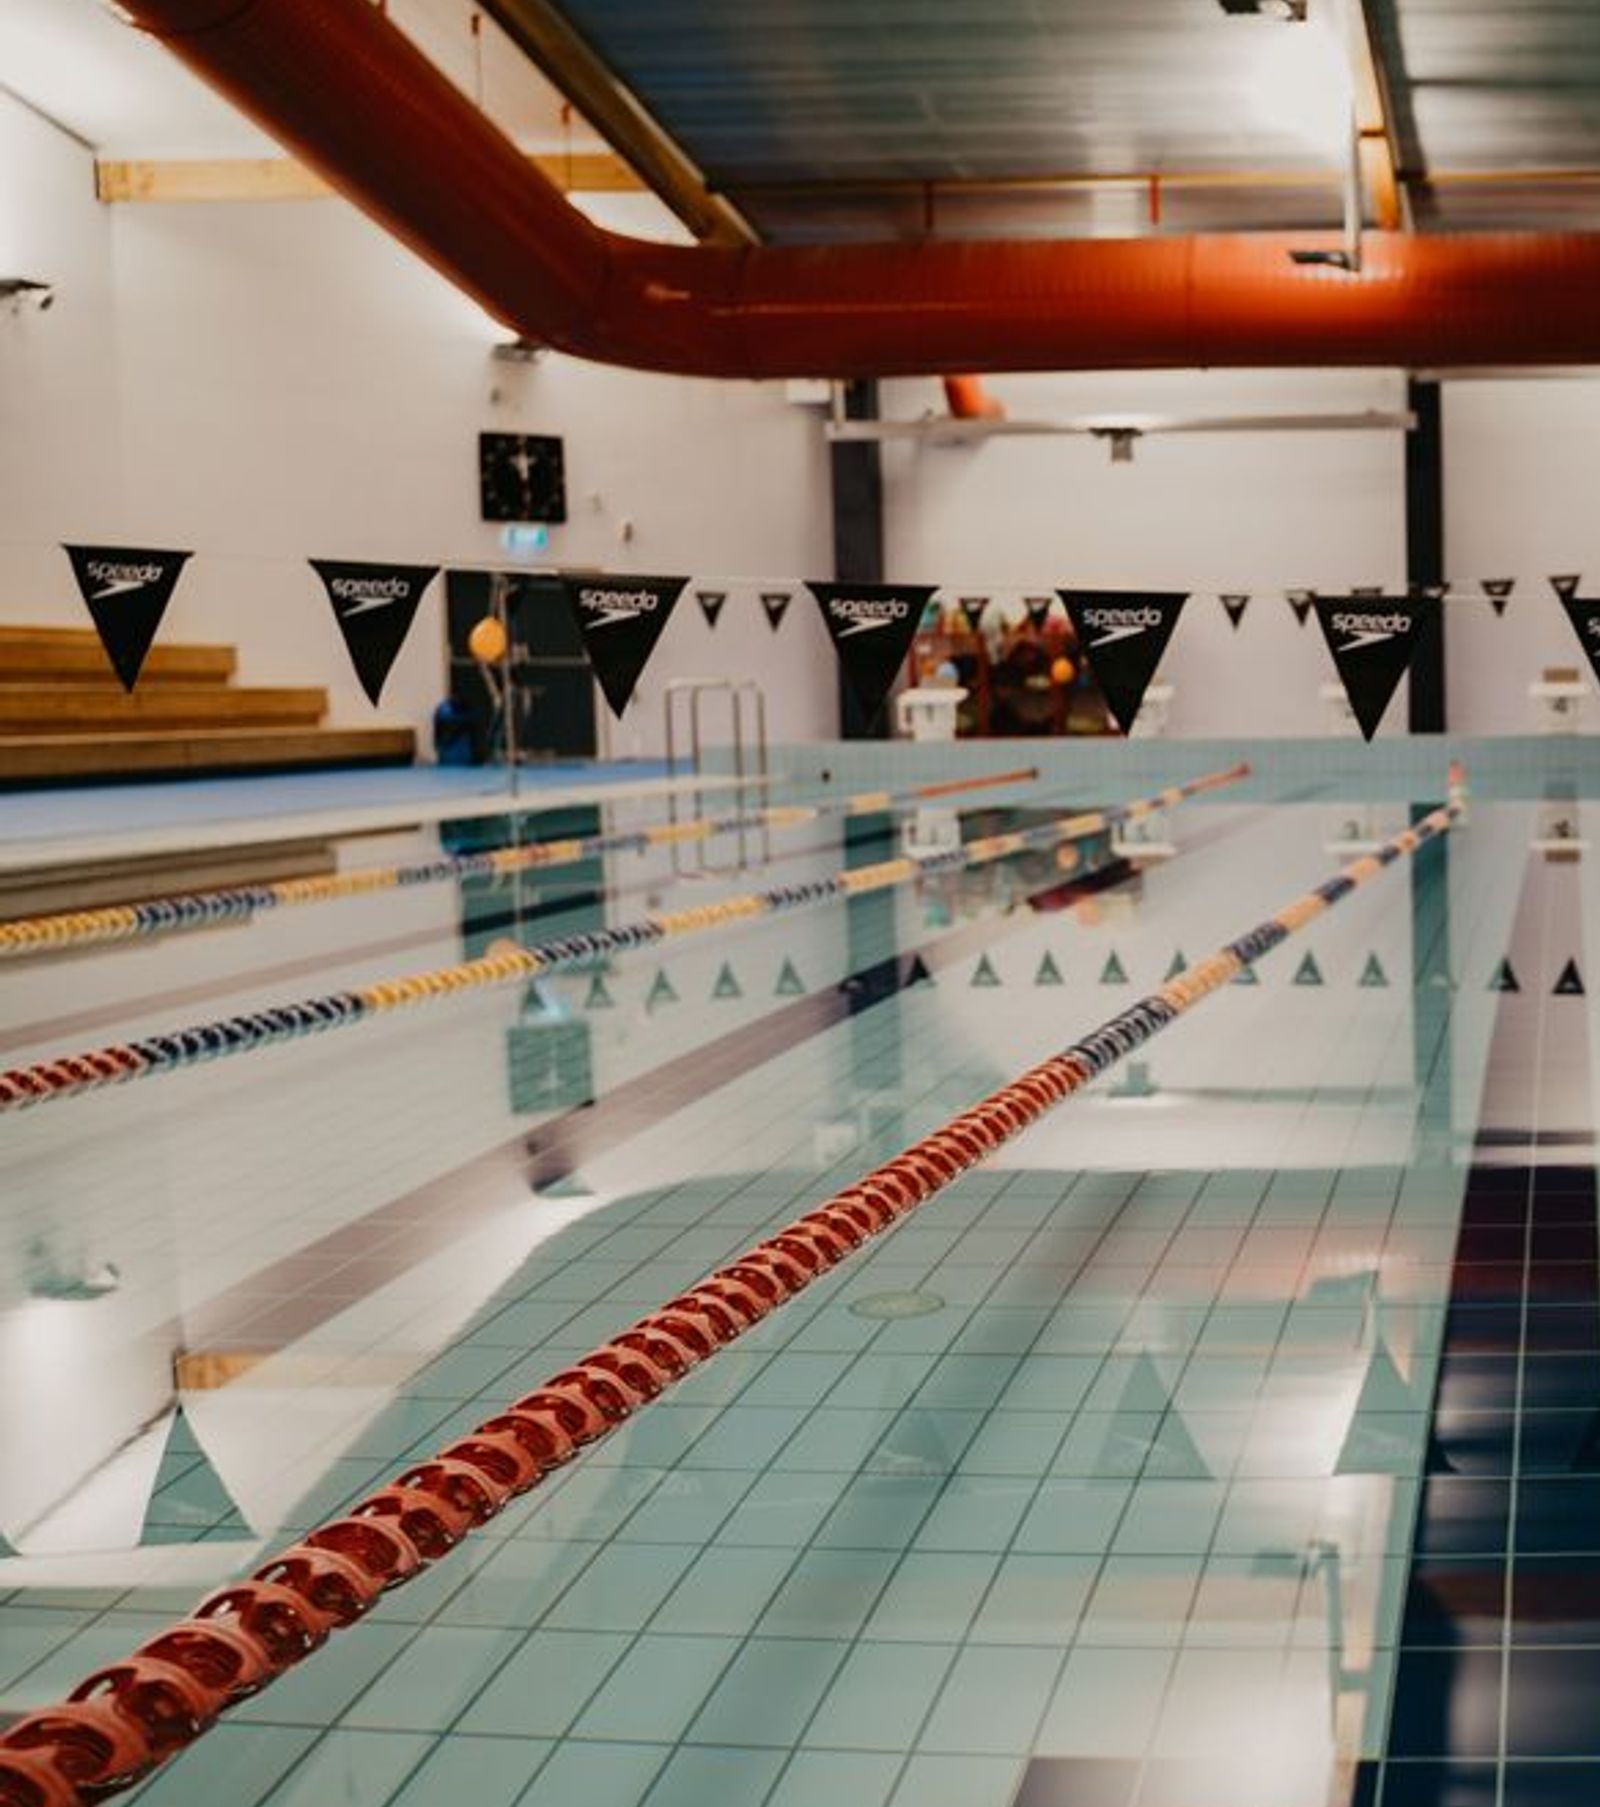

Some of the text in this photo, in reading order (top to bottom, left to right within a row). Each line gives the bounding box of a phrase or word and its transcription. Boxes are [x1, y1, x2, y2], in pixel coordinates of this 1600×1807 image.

[87, 560, 163, 581] speedo
[331, 577, 410, 599] speedo
[580, 588, 659, 611] speedo
[830, 598, 909, 619] speedo
[1083, 606, 1162, 627] speedo
[1332, 612, 1411, 634] speedo
